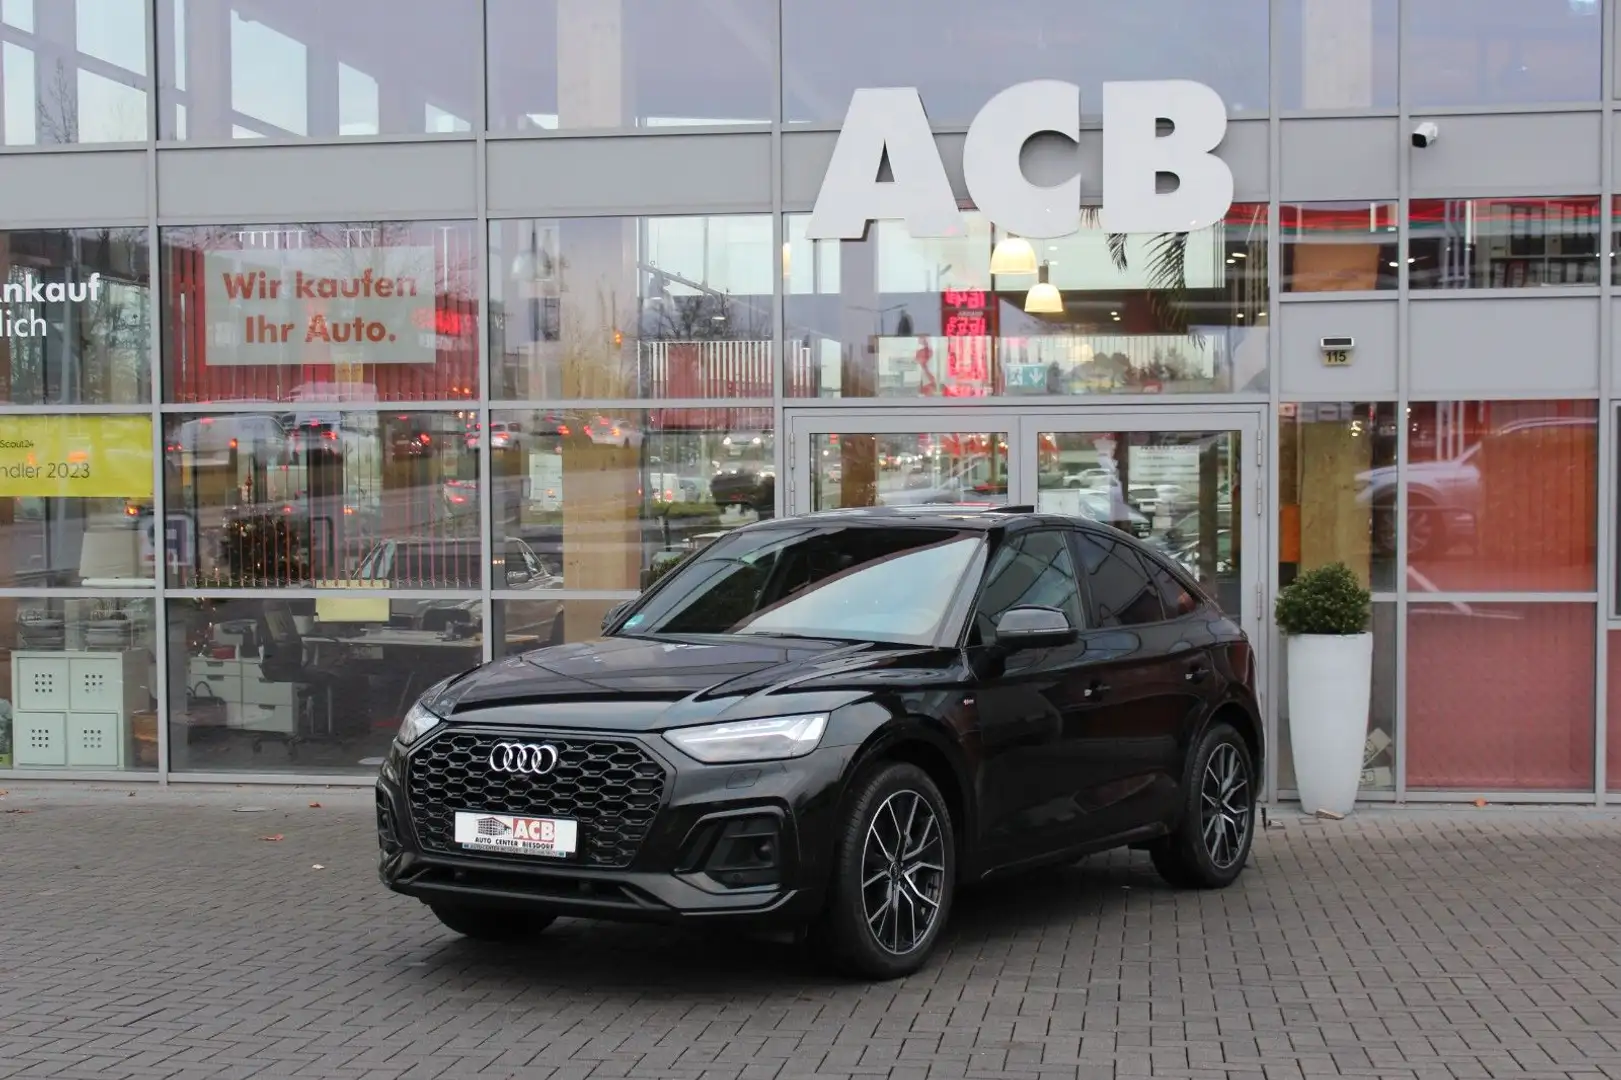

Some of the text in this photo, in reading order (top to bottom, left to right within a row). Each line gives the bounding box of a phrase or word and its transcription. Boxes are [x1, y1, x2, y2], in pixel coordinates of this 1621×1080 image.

[805, 79, 1234, 240] ACB
[0, 272, 101, 303] nkauf
[222, 268, 417, 299] Wir kaufen
[246, 315, 295, 343] Ihr
[305, 314, 397, 343] Auto.
[1326, 351, 1347, 363] 115
[47, 462, 91, 479] 2023
[475, 836, 492, 845] AUTO
[495, 838, 518, 847] CENTER
[522, 842, 554, 850] BIESDORF
[514, 820, 555, 841] ACB
